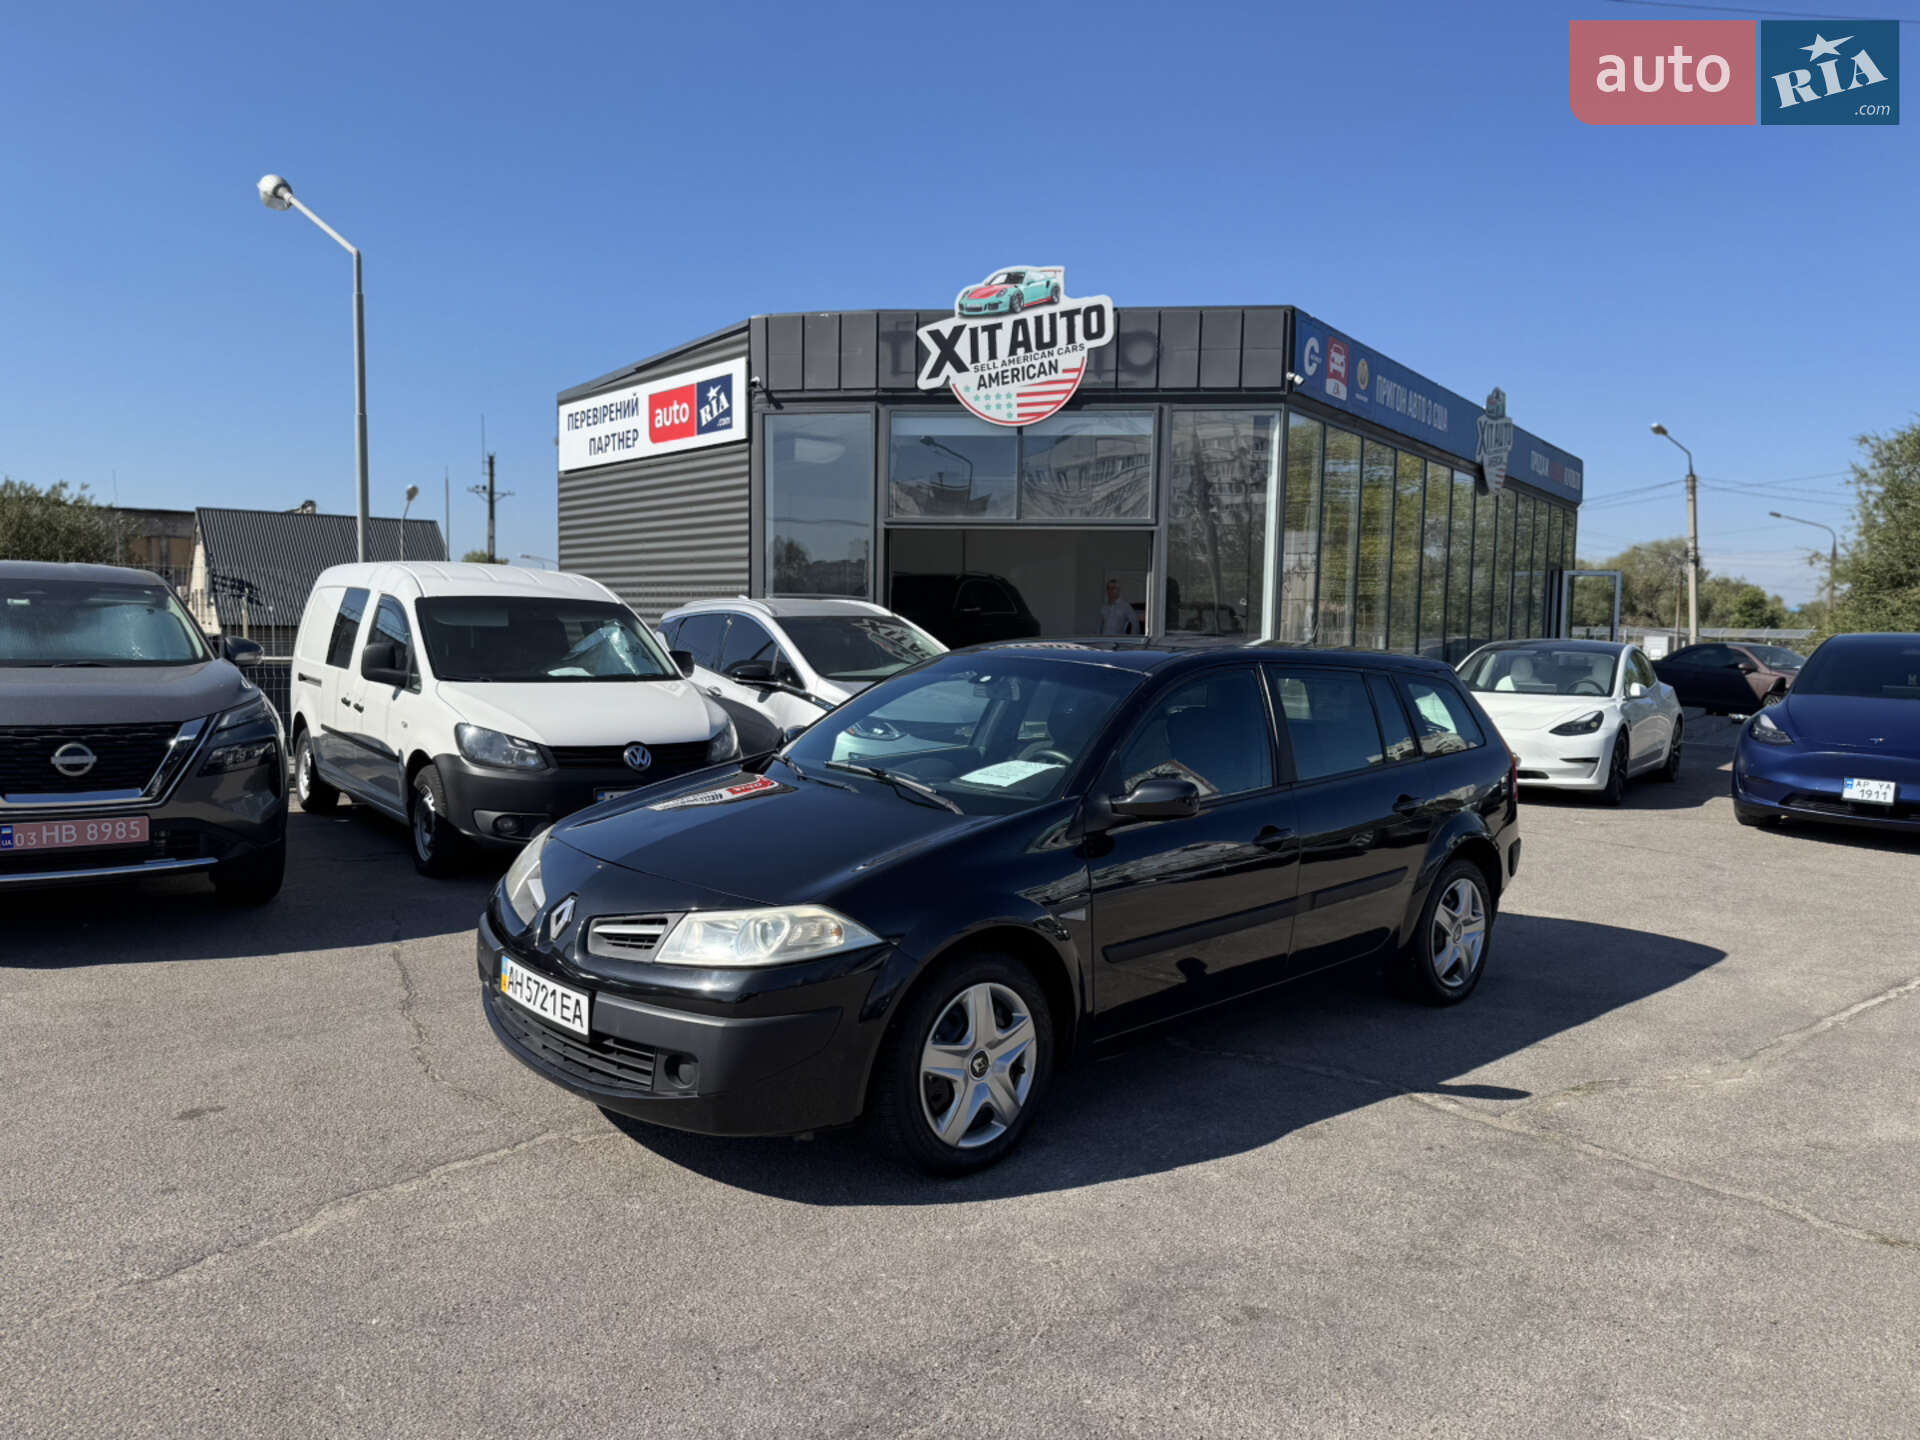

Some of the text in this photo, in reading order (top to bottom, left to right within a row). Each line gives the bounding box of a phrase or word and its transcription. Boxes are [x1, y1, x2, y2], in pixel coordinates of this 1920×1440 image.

[1008, 303, 1106, 358] AUTO
[973, 342, 1086, 374] SELL AMERICAN CARS
[976, 359, 1060, 391] AMERICAN
[567, 392, 640, 432] ПЕРЕВІРЕНИЙ
[654, 392, 731, 428] auto RIA
[588, 428, 640, 456] ПАРТНЕР
[1859, 788, 1888, 801] 1911
[15, 821, 141, 847] 03 HB 8985
